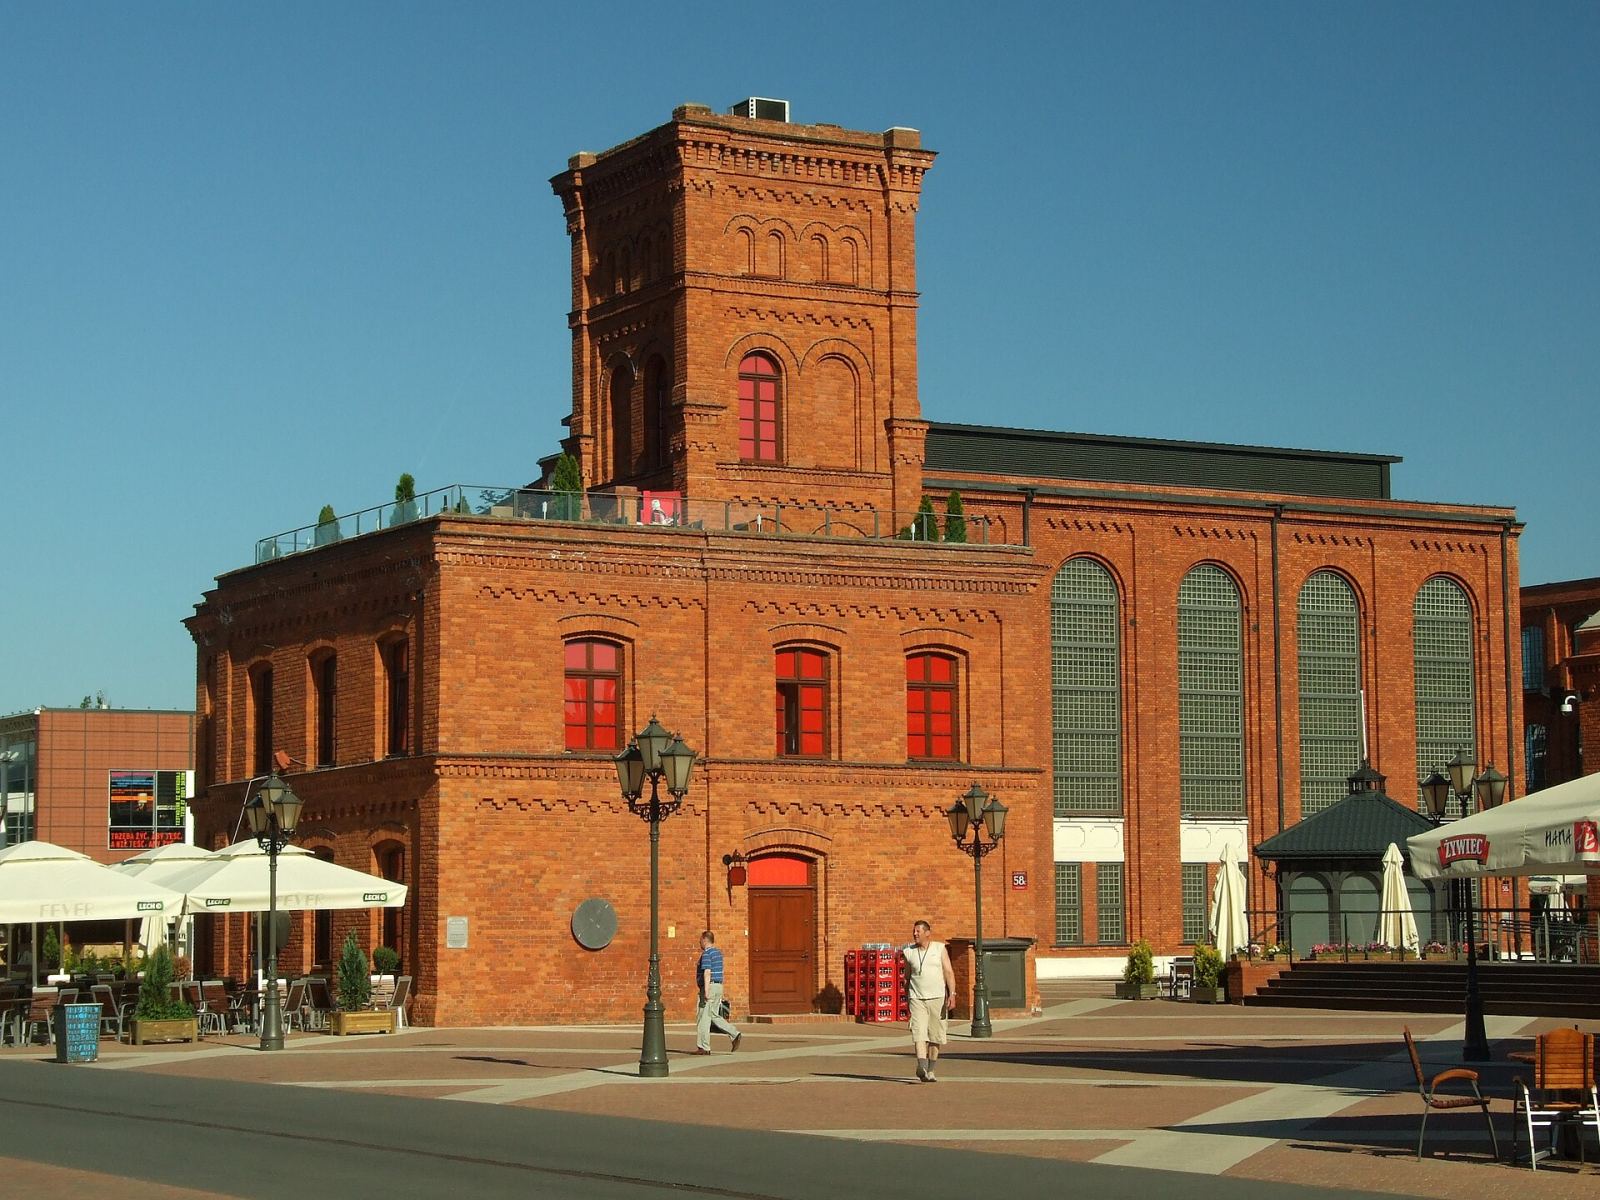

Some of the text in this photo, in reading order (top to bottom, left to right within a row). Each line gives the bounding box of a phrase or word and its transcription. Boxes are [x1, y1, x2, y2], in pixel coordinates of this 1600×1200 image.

[1444, 838, 1483, 858] ŻYWIEC
[40, 902, 95, 918] FEVER
[138, 902, 156, 910] LECH
